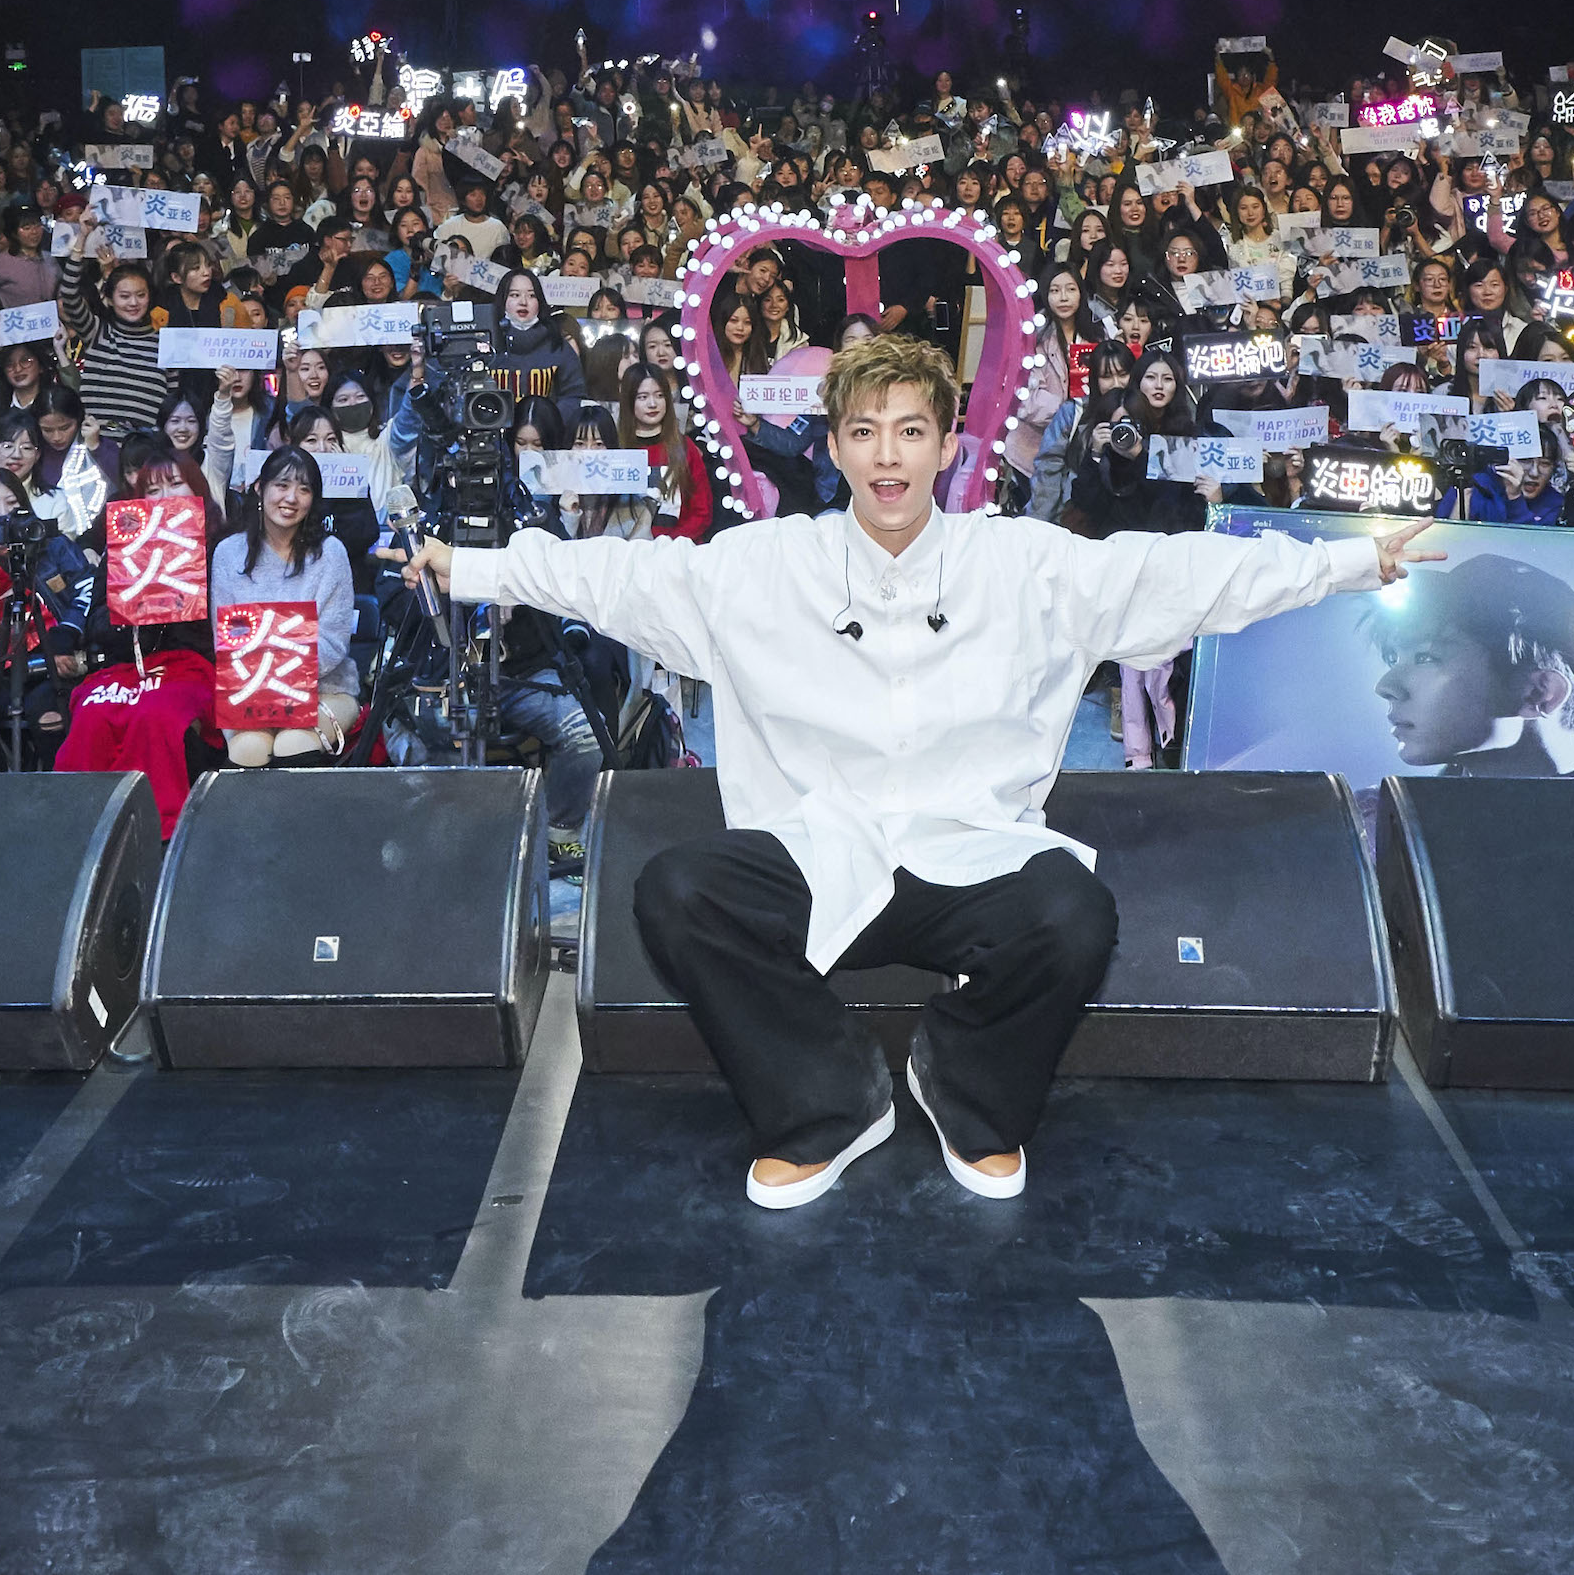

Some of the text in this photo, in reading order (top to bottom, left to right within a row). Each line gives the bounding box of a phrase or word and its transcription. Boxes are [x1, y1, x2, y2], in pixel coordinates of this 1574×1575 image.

[145, 194, 192, 221] 炎亚纶
[106, 227, 142, 249] 炎亚纶
[1336, 231, 1373, 249] 炎亚纶
[471, 260, 498, 284] 炎亚
[1362, 261, 1403, 278] 炎亚纶
[648, 282, 673, 299] 炎亚
[1234, 271, 1275, 291] 炎亚纶
[4, 311, 52, 332] 炎亚纶
[359, 308, 412, 332] 炎亚纶
[1378, 318, 1397, 336] 炎
[1414, 317, 1483, 341] 炎亚
[203, 337, 246, 347] HAPPY
[209, 348, 273, 359] BIRTHDAY
[747, 388, 808, 401] 炎亚纶吧
[1395, 402, 1437, 412] HAPPY
[1258, 419, 1299, 430] HAPPY
[1264, 427, 1324, 441] BIRTHDAY
[1470, 419, 1531, 446] 炎亚纶
[1200, 442, 1255, 470] 炎亚纶
[585, 455, 640, 481] 炎亚纶
[322, 477, 363, 486] THDAY
[119, 505, 198, 602] 炎
[228, 608, 310, 706] 炎
